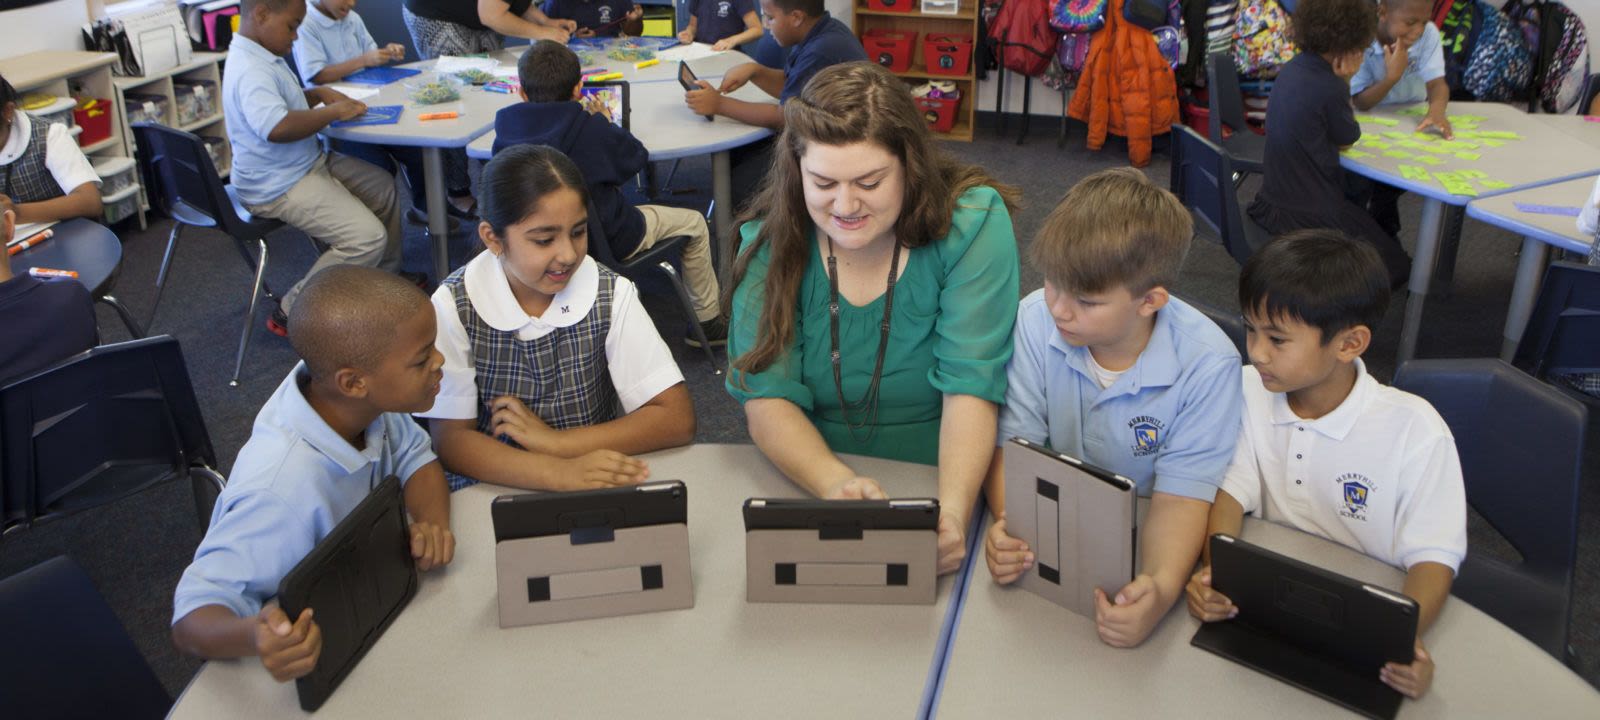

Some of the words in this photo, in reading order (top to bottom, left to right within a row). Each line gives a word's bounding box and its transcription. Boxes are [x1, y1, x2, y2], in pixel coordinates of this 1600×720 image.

[561, 305, 570, 314] M
[1128, 415, 1165, 430] MERRYHILL
[1141, 434, 1152, 442] M
[1336, 473, 1378, 492] MERRYHILL
[1351, 491, 1360, 500] M
[1340, 510, 1367, 521] SCHOOL
